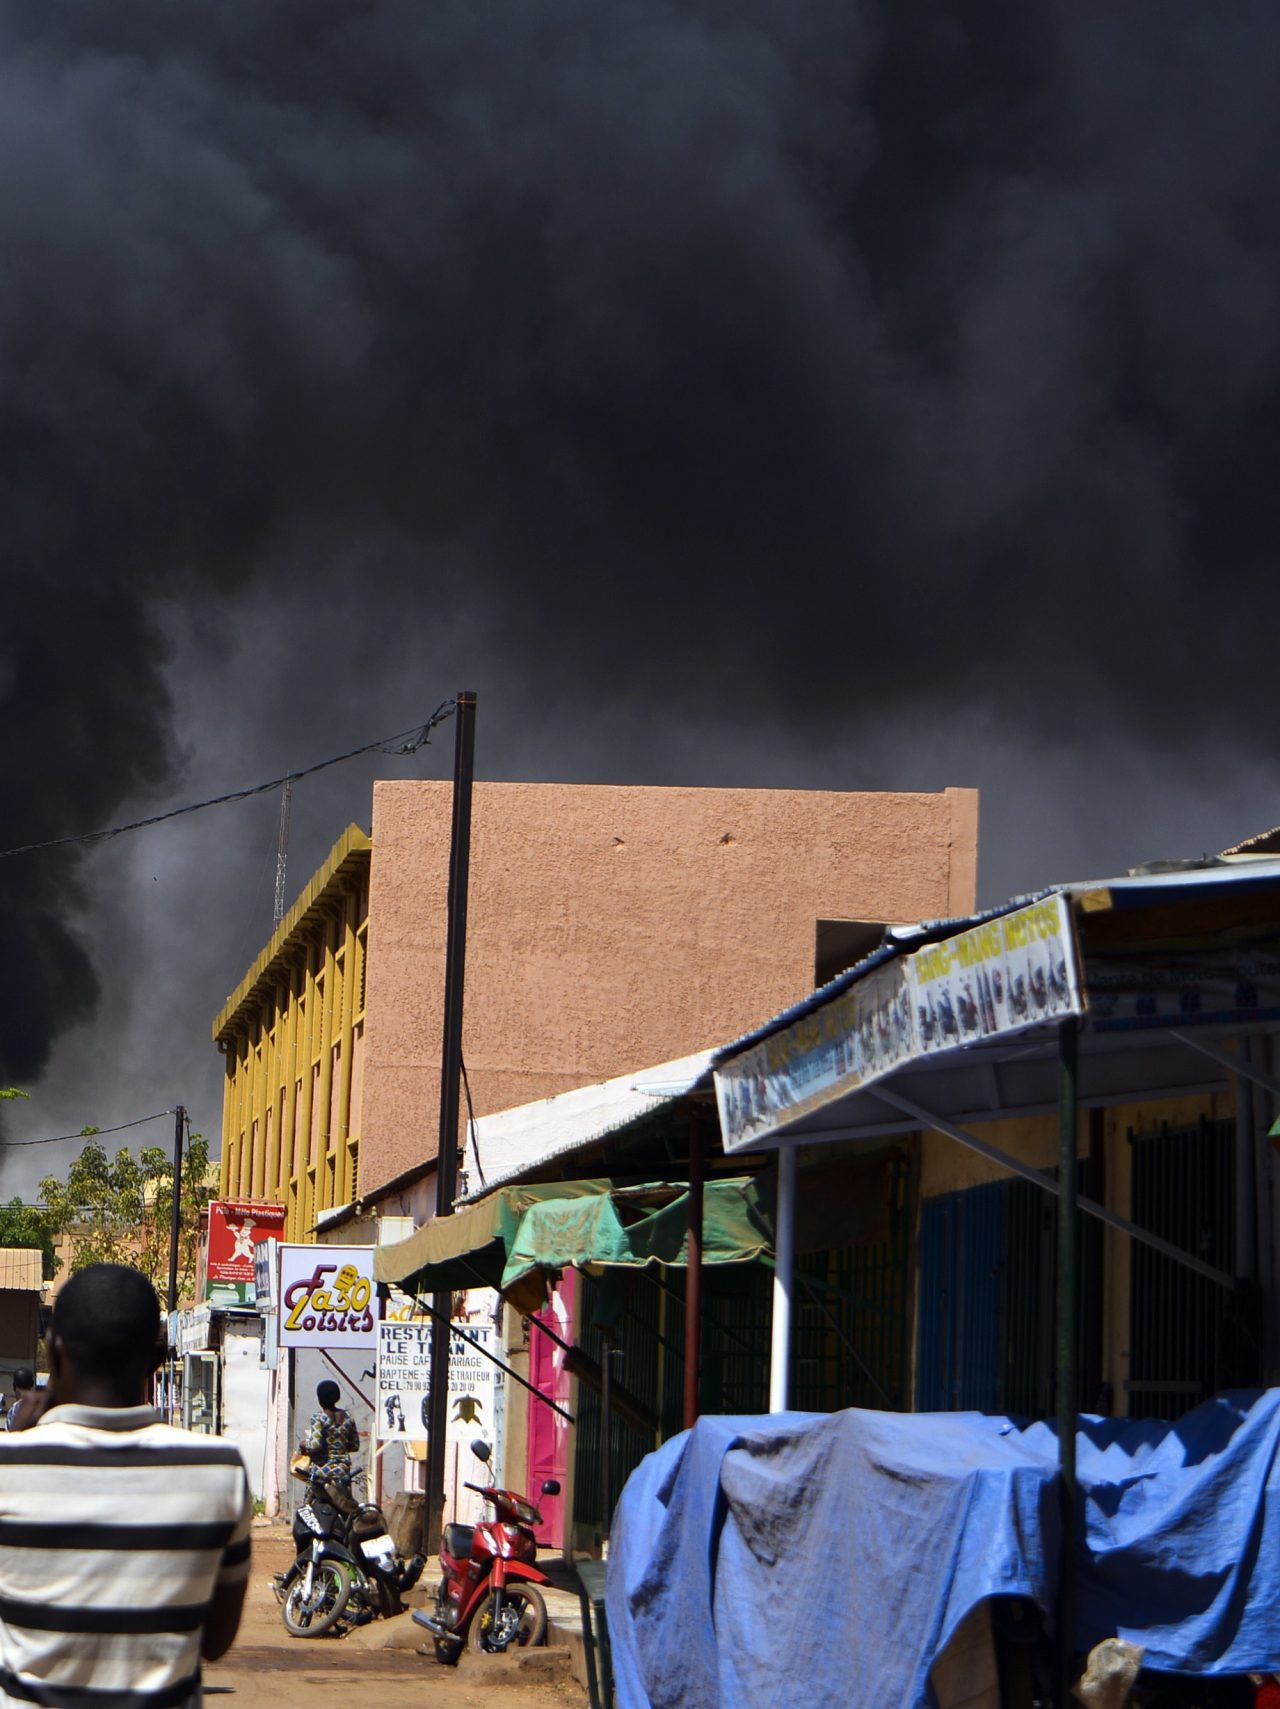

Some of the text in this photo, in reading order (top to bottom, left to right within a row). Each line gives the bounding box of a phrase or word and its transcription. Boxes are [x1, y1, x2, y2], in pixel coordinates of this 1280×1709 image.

[284, 1295, 373, 1332] Loisirs
[380, 1327, 490, 1342] RESTARANT
[387, 1342, 408, 1354] LE
[380, 1355, 432, 1367] PAUSE CAF
[456, 1371, 490, 1382] TRAITEUR
